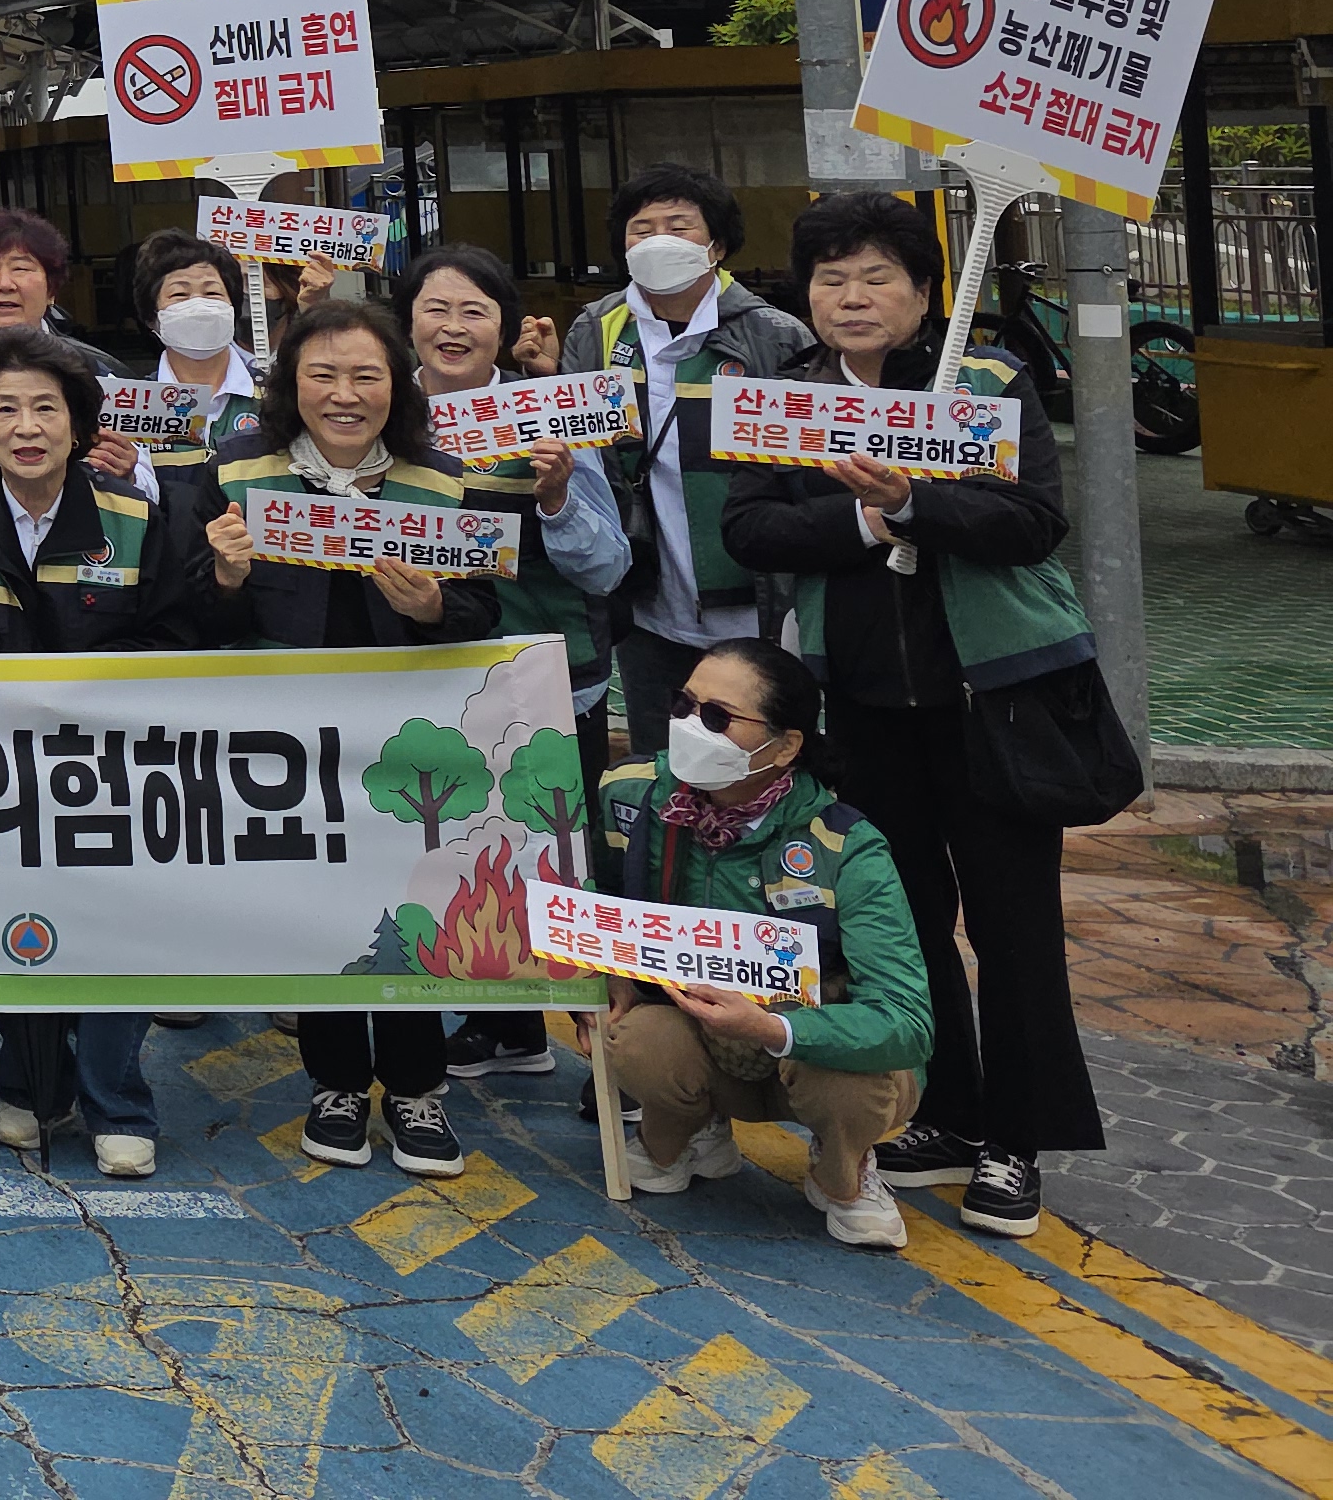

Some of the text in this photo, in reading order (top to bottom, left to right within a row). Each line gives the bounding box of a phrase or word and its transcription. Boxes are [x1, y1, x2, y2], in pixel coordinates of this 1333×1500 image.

[209, 10, 359, 66] 산에서 흡연
[997, 8, 1152, 99] 농산폐기물
[213, 69, 335, 121] 절대 금지
[978, 70, 1162, 165] 소각 절대 금지
[438, 408, 630, 454] 작은 불도 위험해요!
[732, 420, 997, 469] 작은 불도 위험해요!
[263, 528, 315, 555] 작은
[322, 534, 375, 560] 불도
[547, 925, 801, 996] 작은 불도 위험해요!
